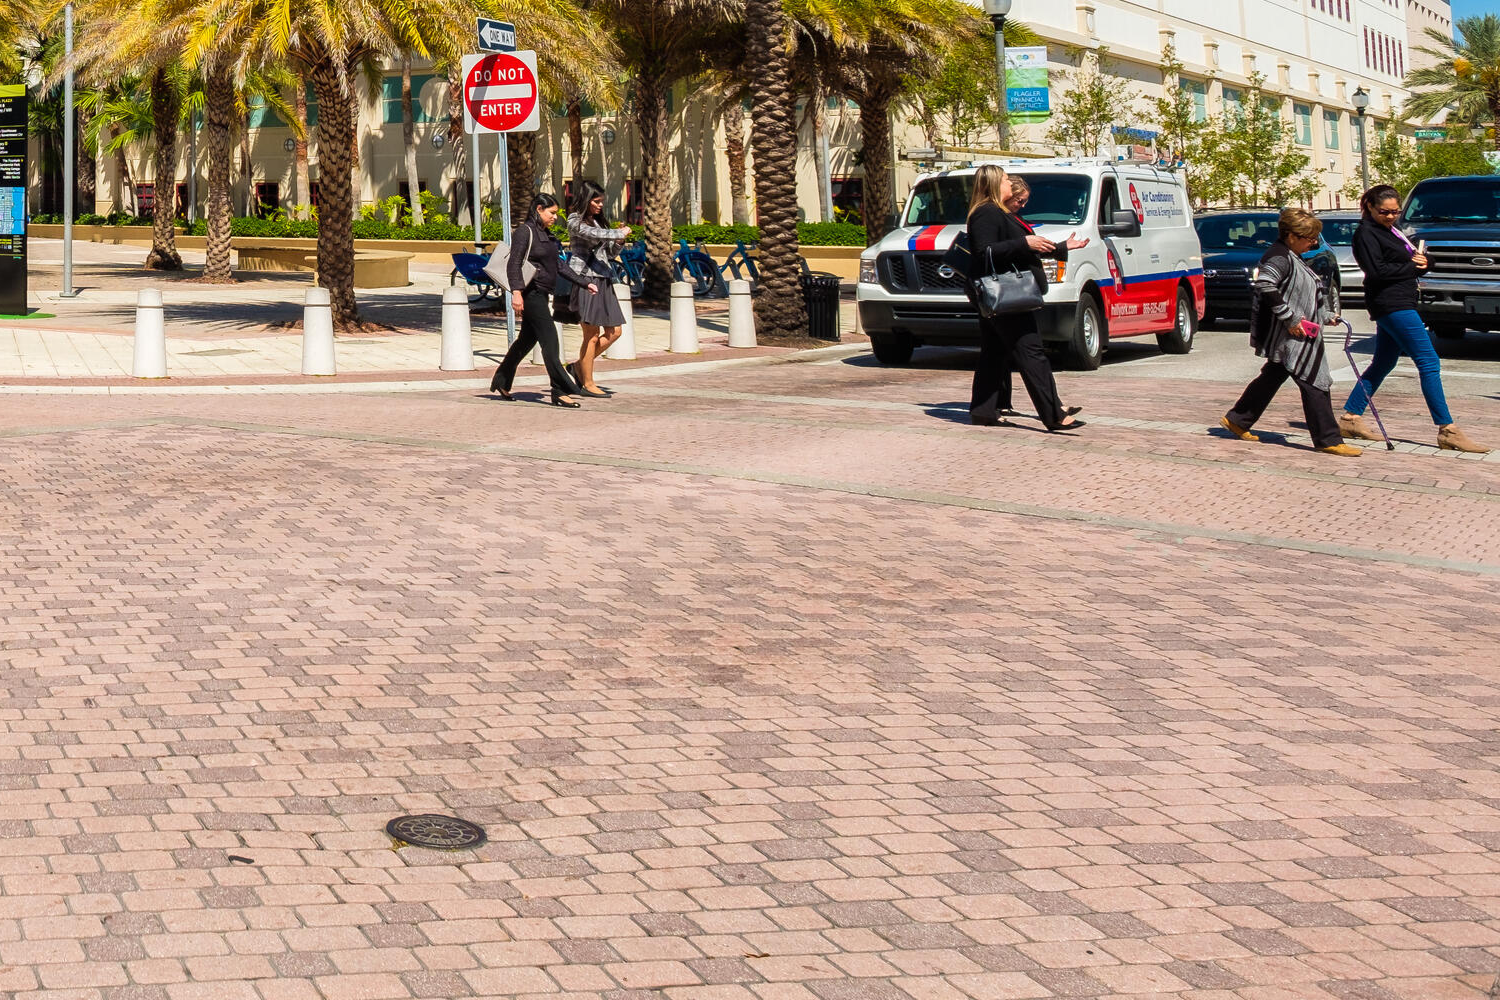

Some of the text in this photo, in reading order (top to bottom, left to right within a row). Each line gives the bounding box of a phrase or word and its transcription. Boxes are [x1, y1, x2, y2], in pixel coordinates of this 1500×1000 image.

[490, 29, 514, 45] ONE WAY
[474, 68, 525, 83] DO NOT
[480, 103, 521, 116] ENTER
[1149, 192, 1175, 205] Conditioning
